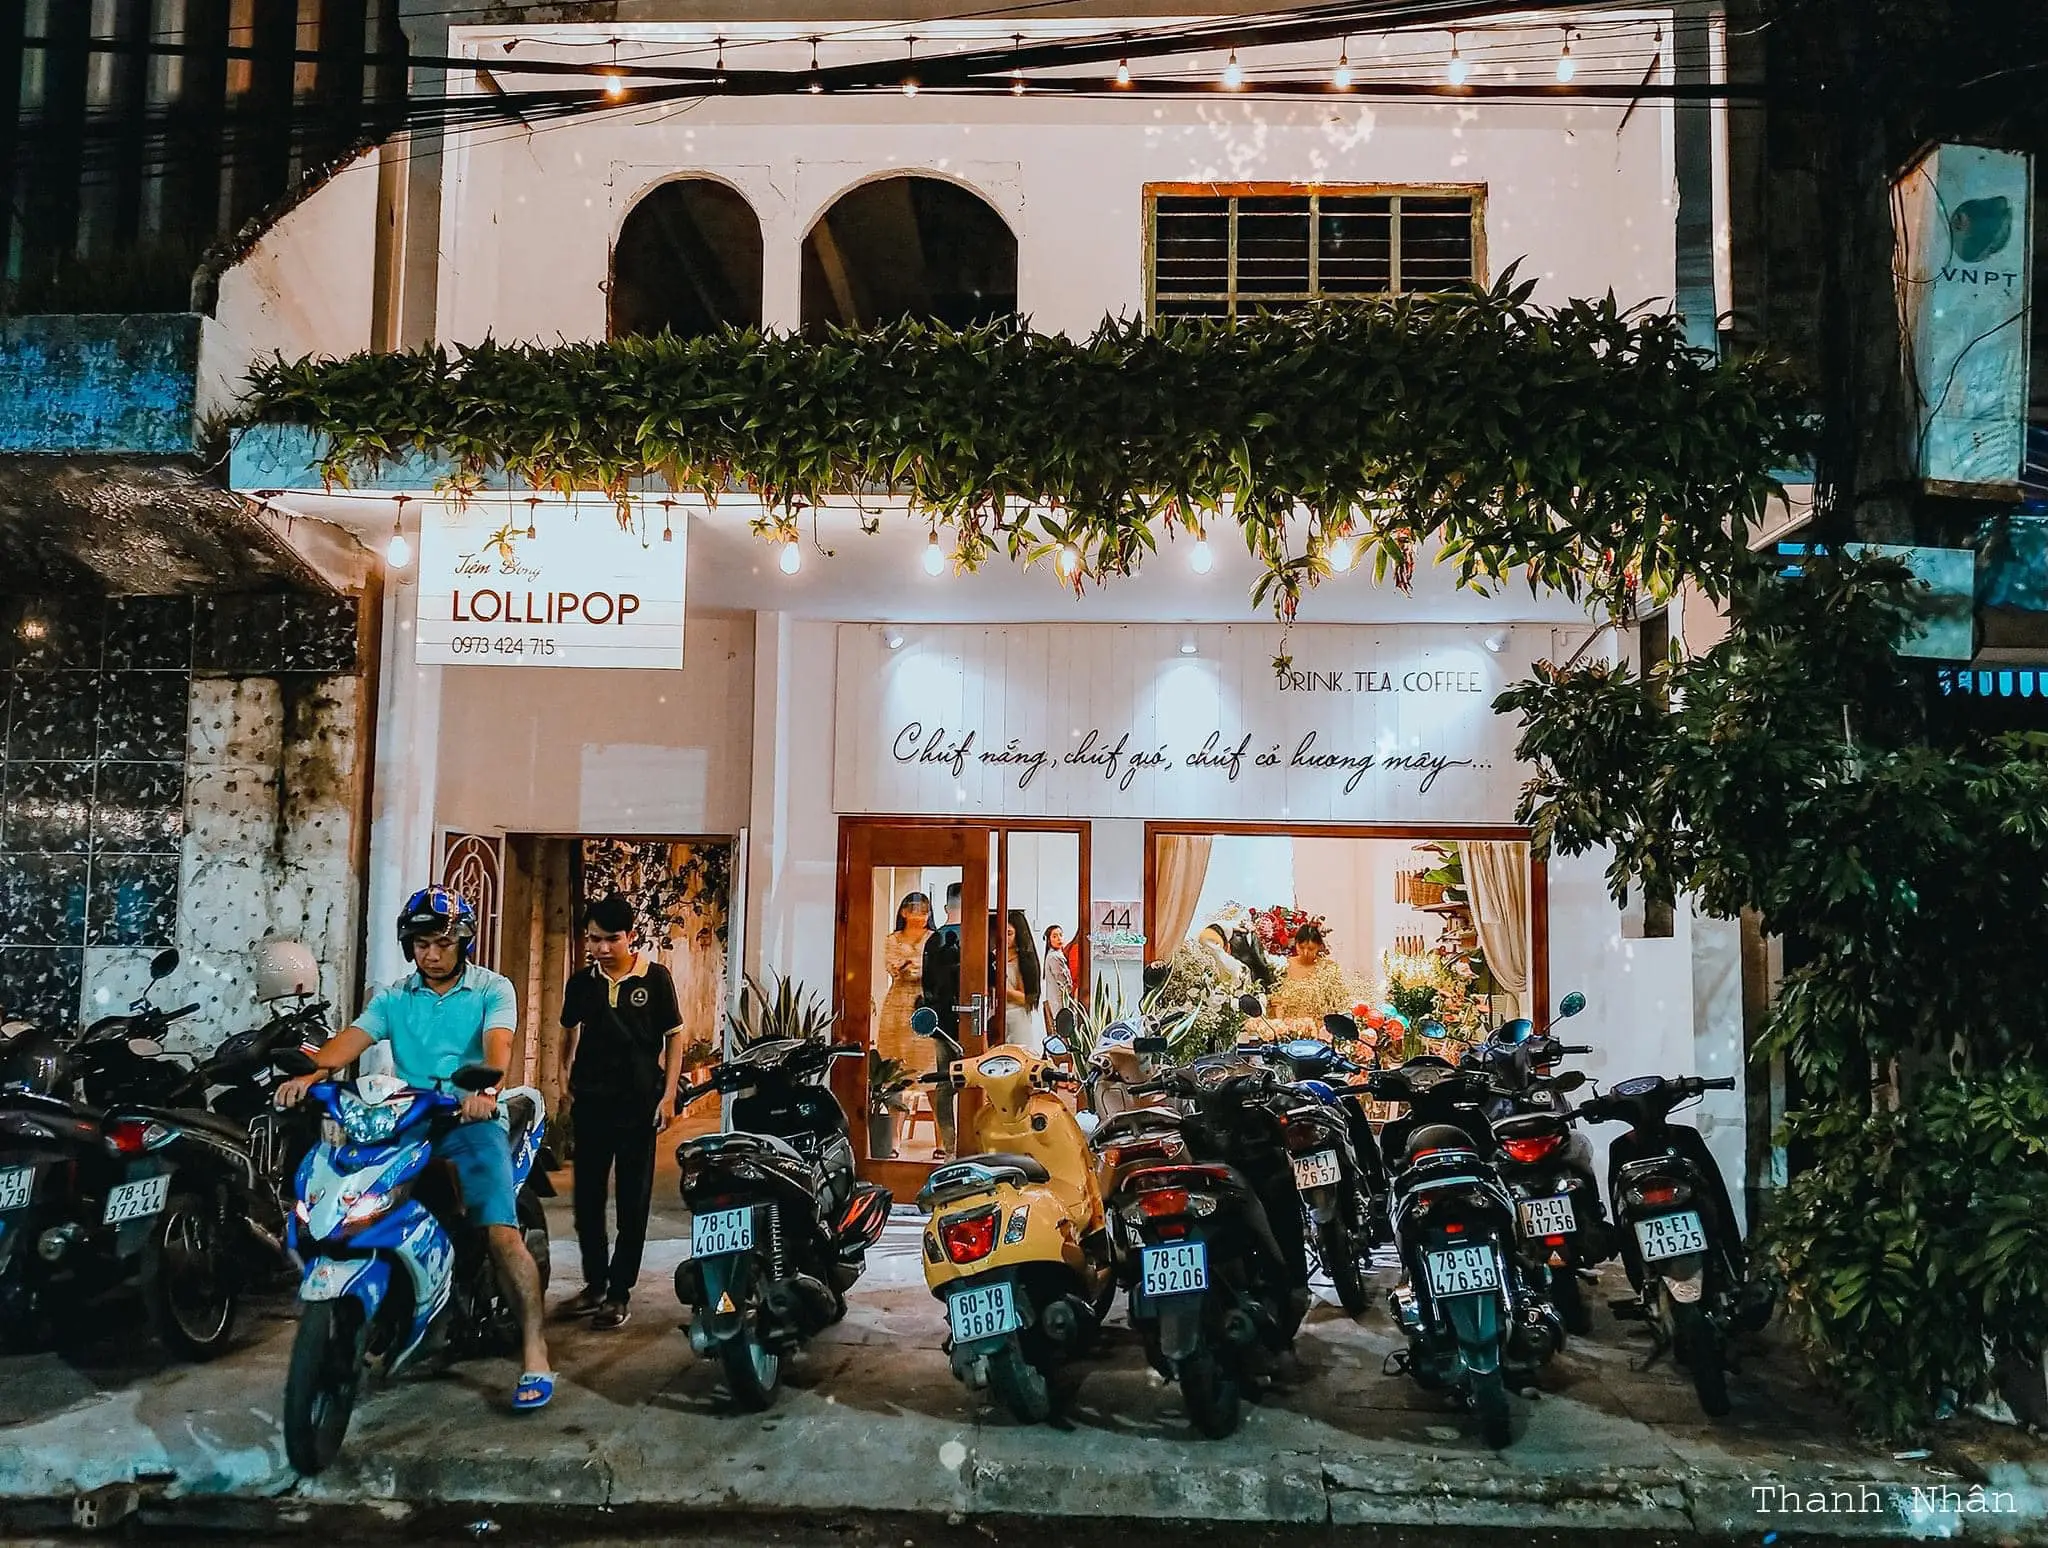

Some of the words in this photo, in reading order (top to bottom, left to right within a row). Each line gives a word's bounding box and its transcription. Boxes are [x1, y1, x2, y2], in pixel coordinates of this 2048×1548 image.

[1941, 267, 2017, 287] VNPT
[452, 589, 640, 625] LOLLIPOP
[452, 636, 489, 654] 0973
[494, 637, 523, 655] 424
[529, 638, 555, 655] 715
[1102, 909, 1131, 930] 44
[1295, 1154, 1329, 1174] 78-C1
[117, 1180, 158, 1203] 78-C1
[107, 1195, 161, 1221] 372.44
[1527, 1200, 1564, 1218] 78-C1
[701, 1210, 742, 1234] 78-C1
[1527, 1215, 1574, 1235] 617.56
[1645, 1216, 1690, 1238] 78-E1
[695, 1229, 750, 1254] 400.46
[1645, 1231, 1702, 1258] 215.25
[1152, 1247, 1194, 1271] 78-C1
[1436, 1248, 1483, 1272] 78-G1
[1147, 1268, 1203, 1292] 592.06
[960, 1288, 1004, 1316] 60-Y8
[962, 1309, 1005, 1337] 3687
